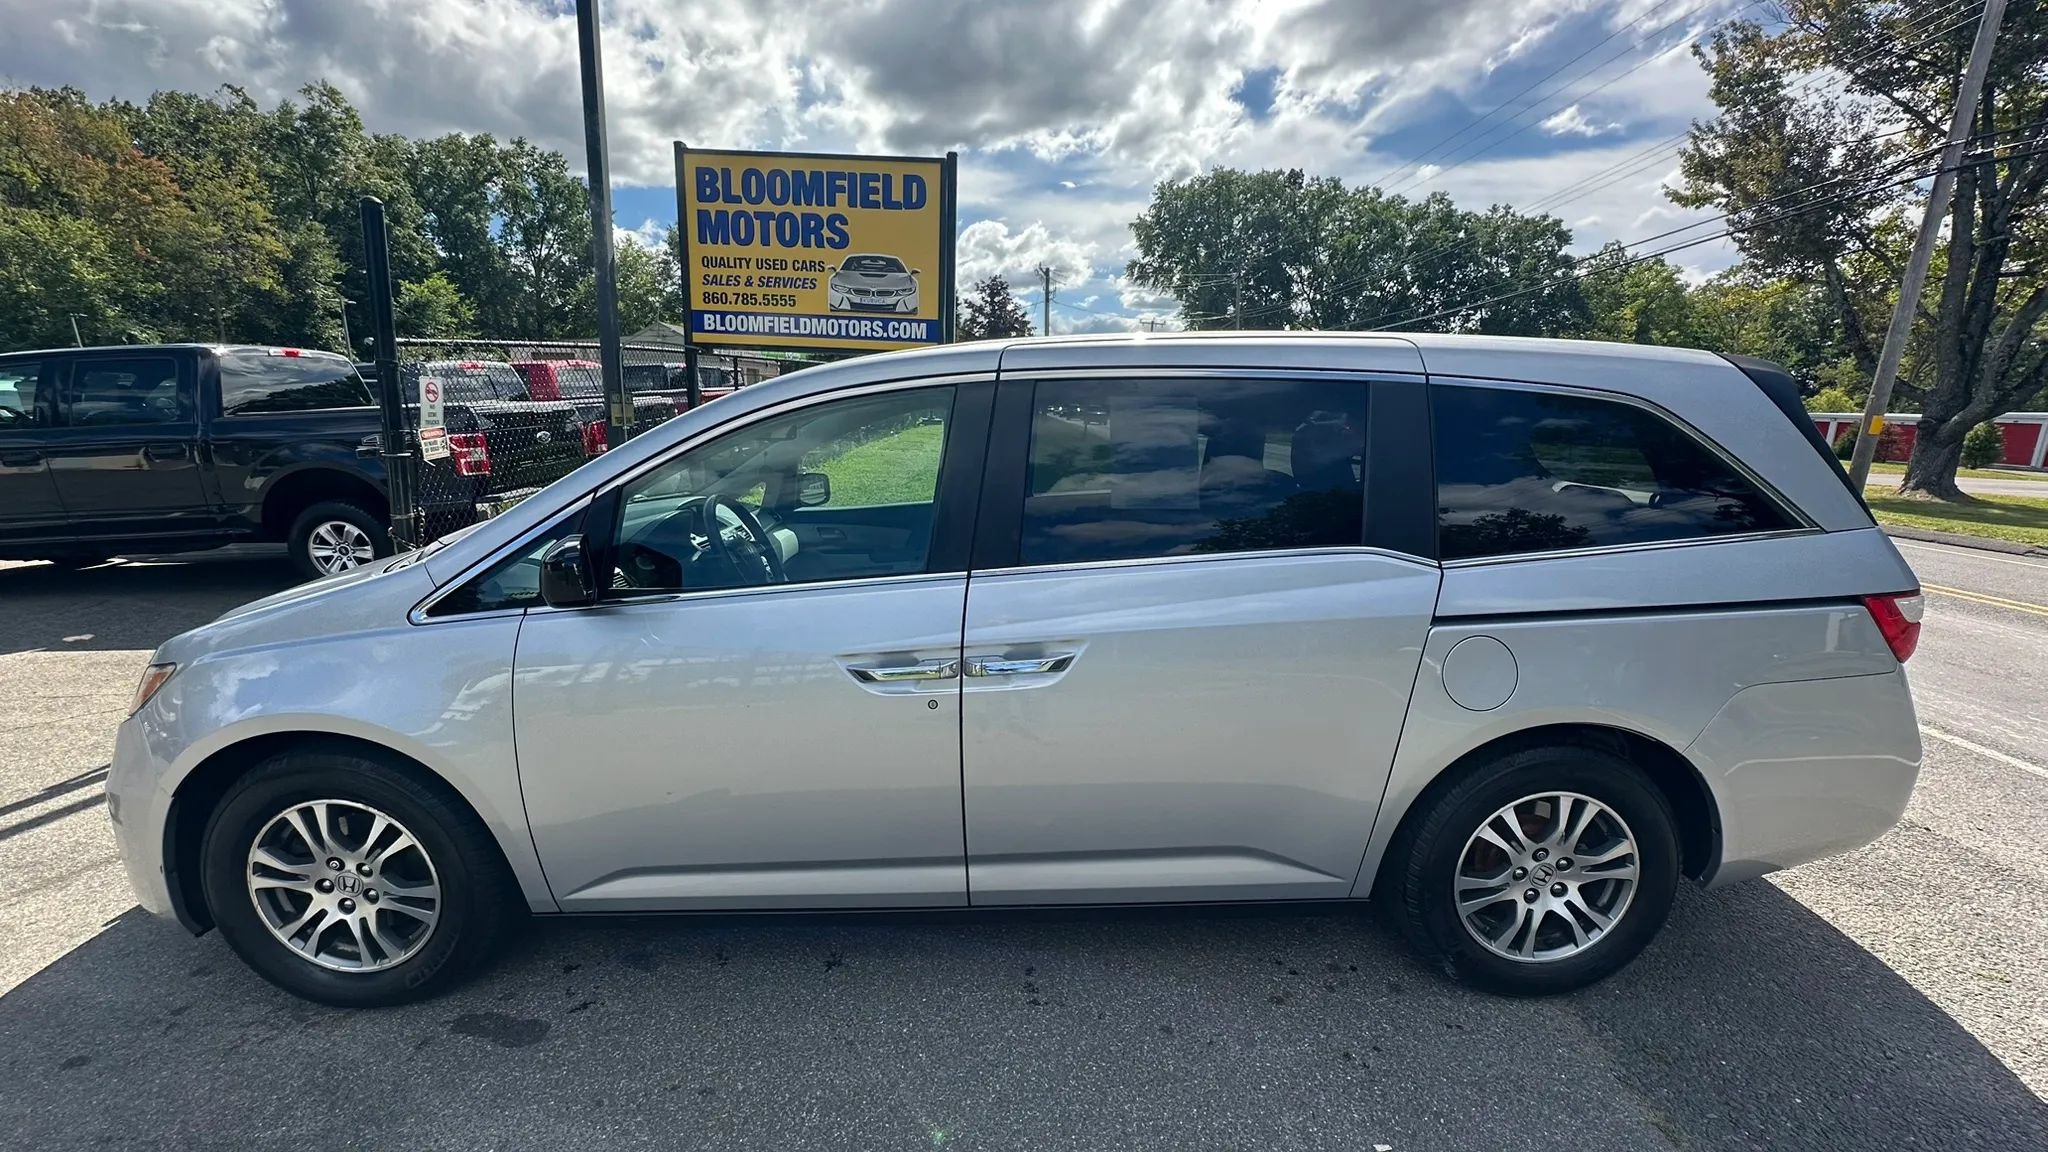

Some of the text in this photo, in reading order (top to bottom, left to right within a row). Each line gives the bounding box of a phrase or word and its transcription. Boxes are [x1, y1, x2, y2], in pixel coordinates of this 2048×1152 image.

[695, 166, 927, 210] BLOOMFIELD
[697, 209, 850, 249] MOTORS
[702, 256, 825, 272] QUALITY USED CARS
[702, 274, 817, 289] SALES & SERVICES
[702, 292, 796, 307] 860.785.5555
[703, 314, 927, 339] BLOOMFIELDMOTORS.COM
